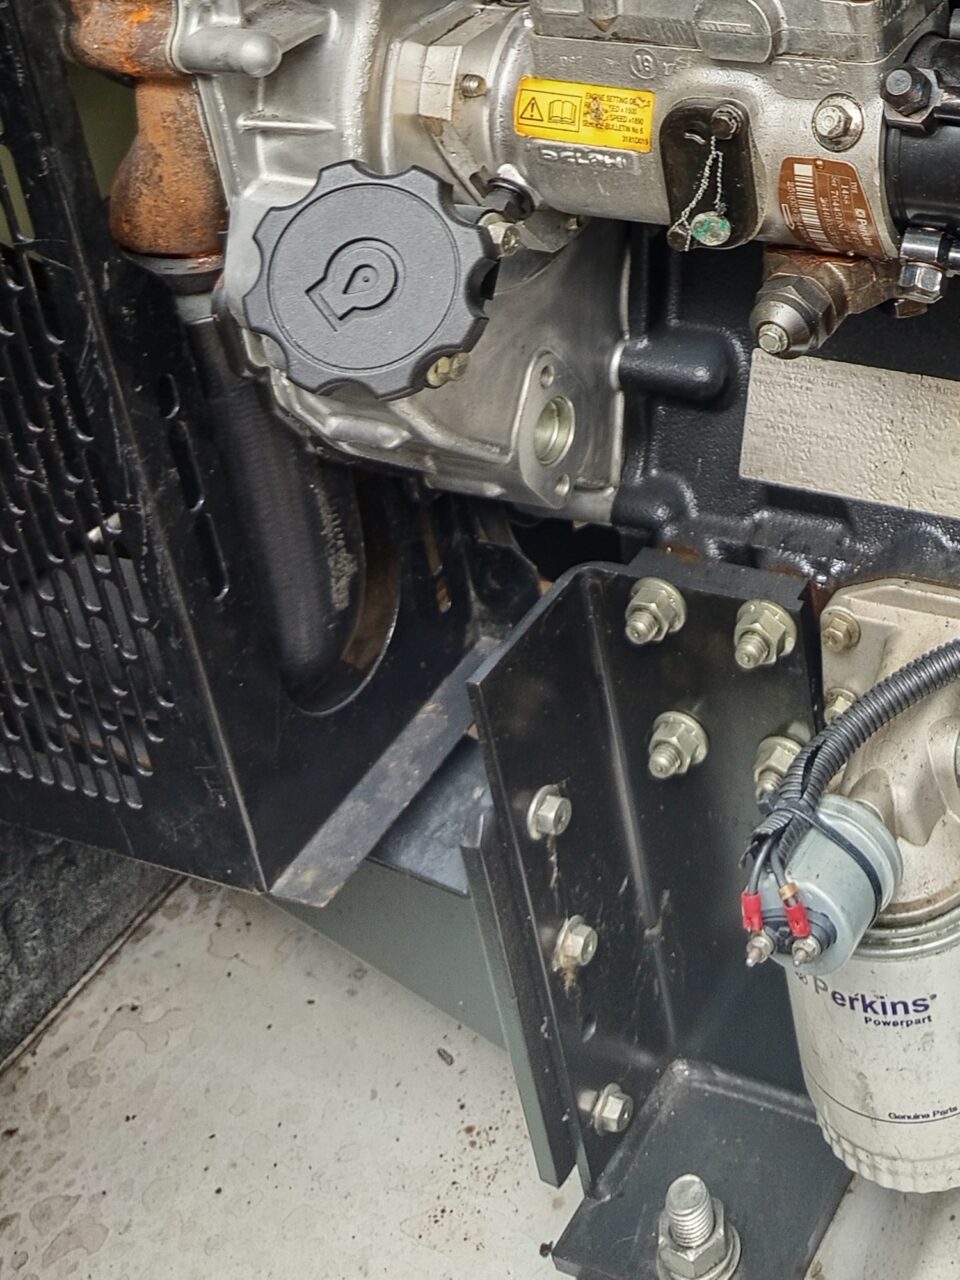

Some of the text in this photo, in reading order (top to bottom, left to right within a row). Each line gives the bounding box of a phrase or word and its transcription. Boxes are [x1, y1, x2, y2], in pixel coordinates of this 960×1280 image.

[814, 978, 931, 1017] Perkins
[863, 1014, 933, 1028] Powerpart
[888, 1104, 959, 1120] Genuine Parts
